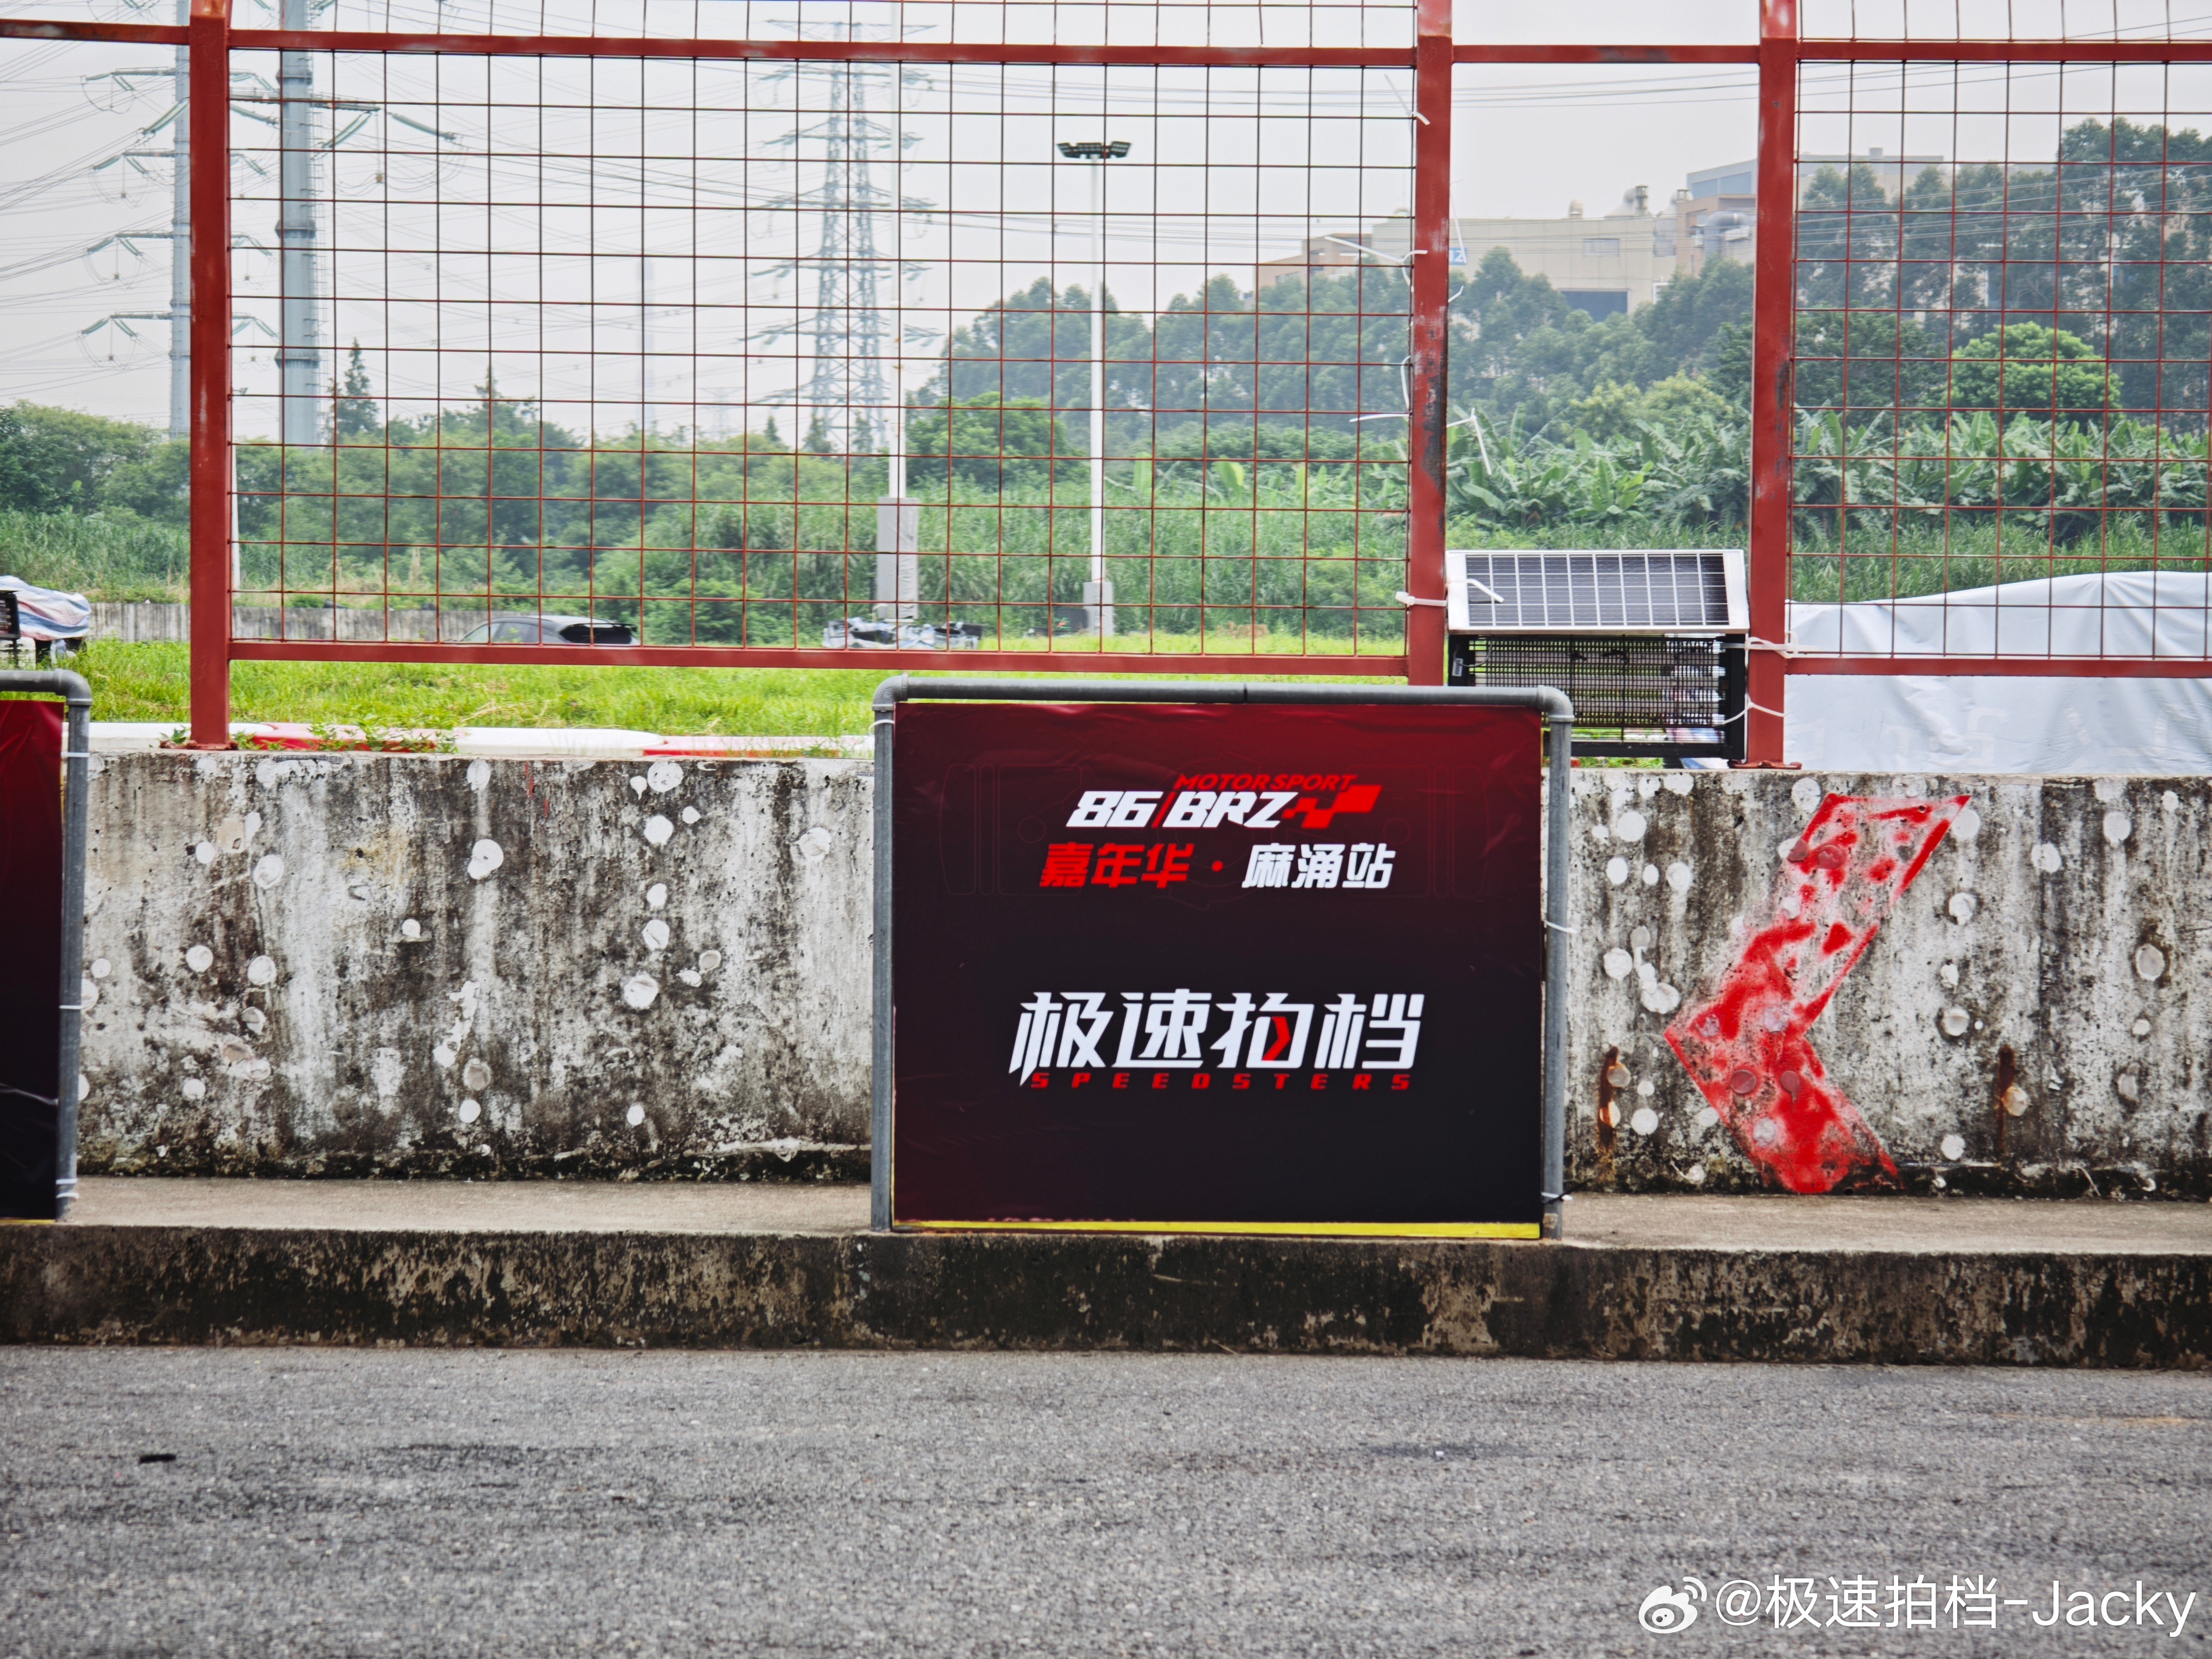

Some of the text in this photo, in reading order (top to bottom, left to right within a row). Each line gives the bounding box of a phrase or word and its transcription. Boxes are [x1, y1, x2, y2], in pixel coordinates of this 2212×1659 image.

[1174, 773, 1358, 790] MOTORSPORT
[1008, 988, 1425, 1087] 极速拍档
[1031, 1073, 1410, 1090] SPEEDSTERS
